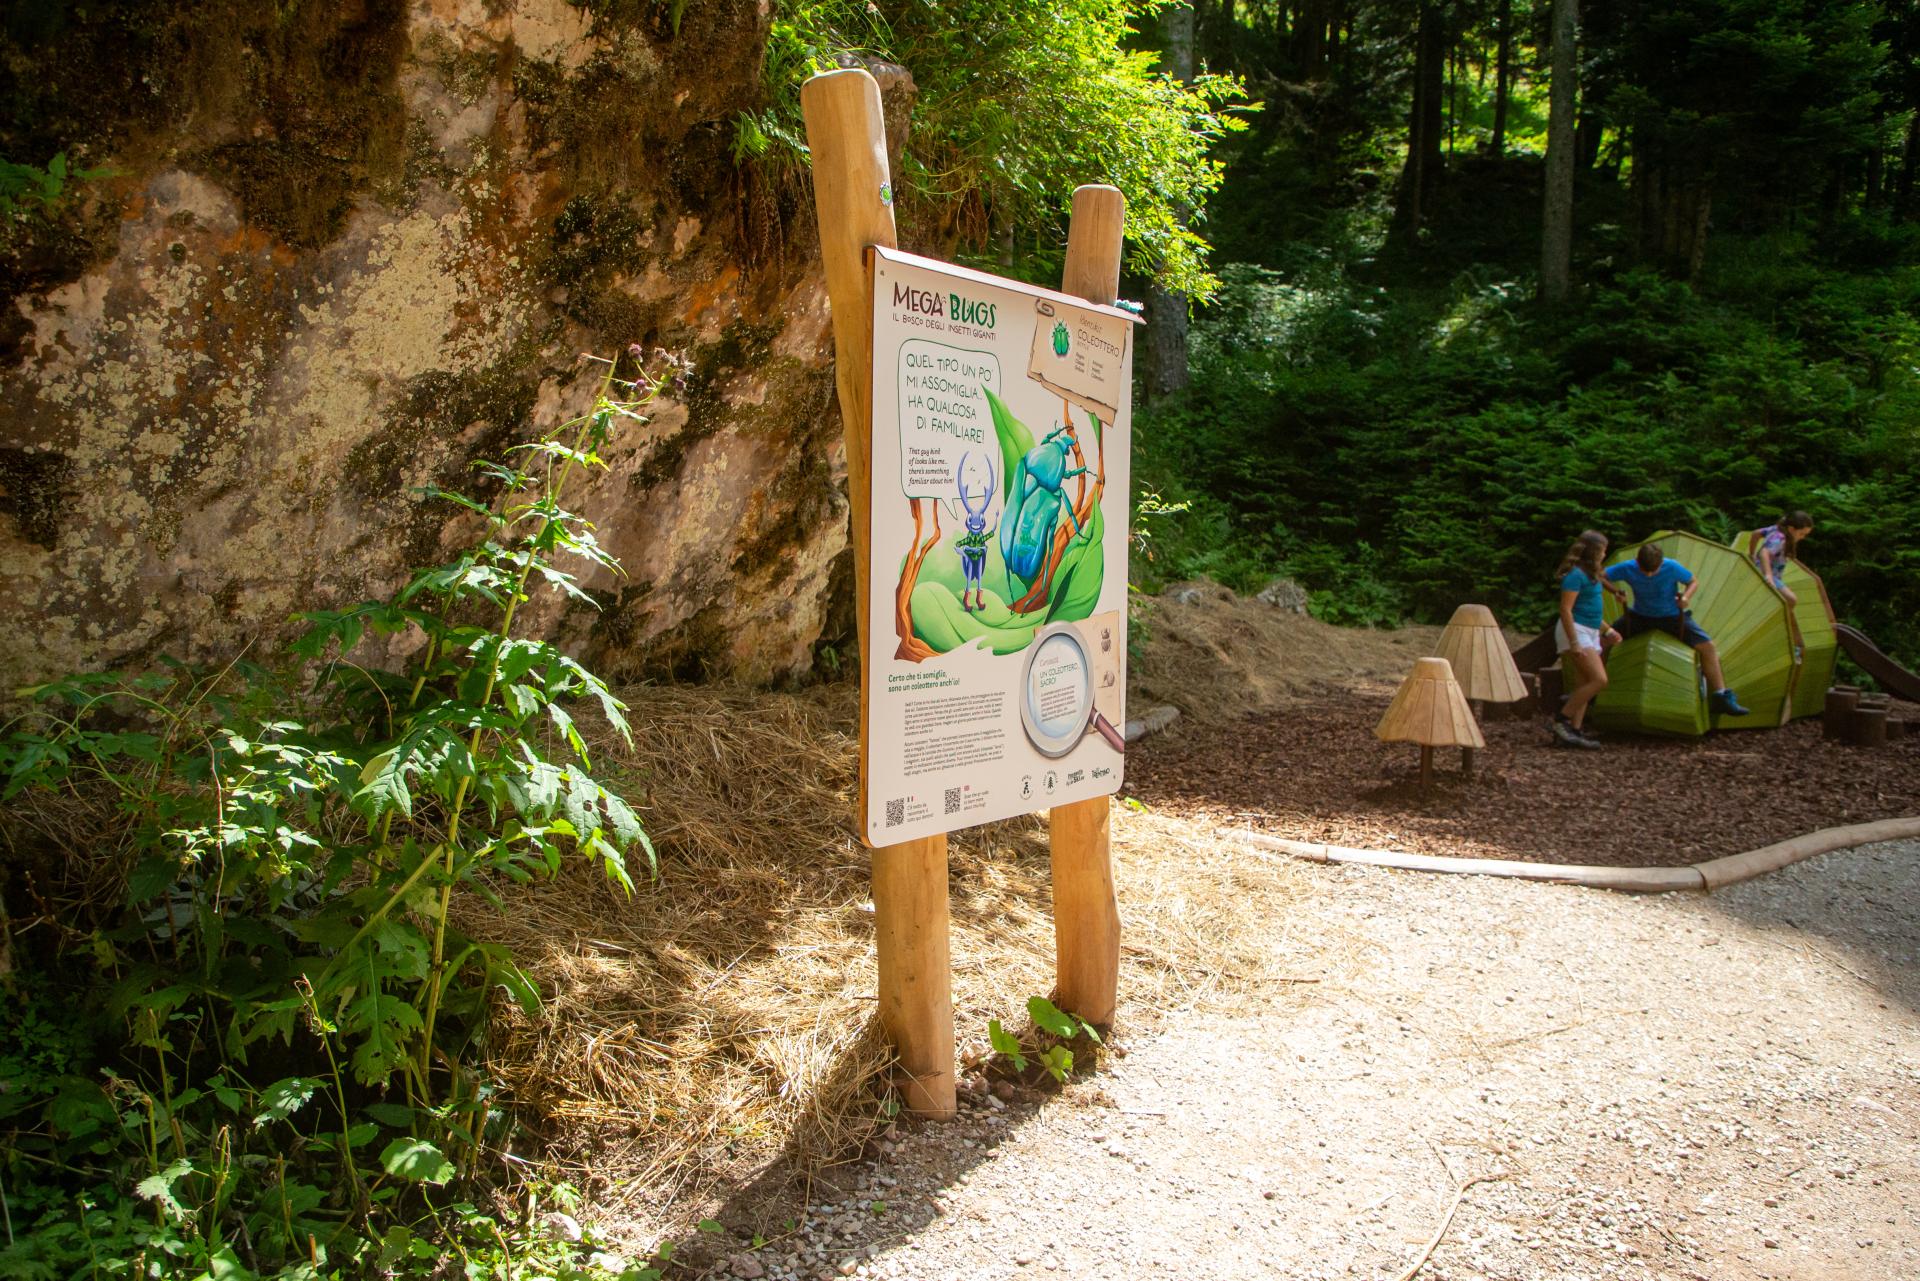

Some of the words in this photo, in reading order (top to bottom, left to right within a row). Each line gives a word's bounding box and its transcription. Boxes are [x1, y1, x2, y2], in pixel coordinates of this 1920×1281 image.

[893, 281, 943, 316] MEGA
[949, 293, 997, 329] BUGS
[893, 313, 899, 321] IL
[925, 319, 944, 331] DEGLI
[948, 324, 971, 336] INSETTI
[972, 329, 996, 341] GIGANTI
[1078, 328, 1120, 358] COLEOTTERO
[906, 353, 934, 368] QUEL
[937, 358, 958, 372] TIPO
[961, 364, 976, 378] UN
[906, 376, 918, 388] MI
[908, 394, 923, 409] HA
[926, 397, 976, 420] QUALCOSA
[916, 415, 926, 430] DI
[931, 418, 984, 444] FAMILIARE!
[908, 447, 920, 455] That
[908, 458, 914, 466] of
[914, 457, 928, 465] looks
[928, 457, 937, 465] like
[925, 468, 950, 476] something
[908, 477, 929, 486] familiar
[929, 477, 943, 485] about
[888, 674, 905, 683] Certo
[905, 672, 916, 681] che
[916, 671, 921, 680] ti
[888, 684, 901, 693] sono
[911, 680, 939, 691] coleottero
